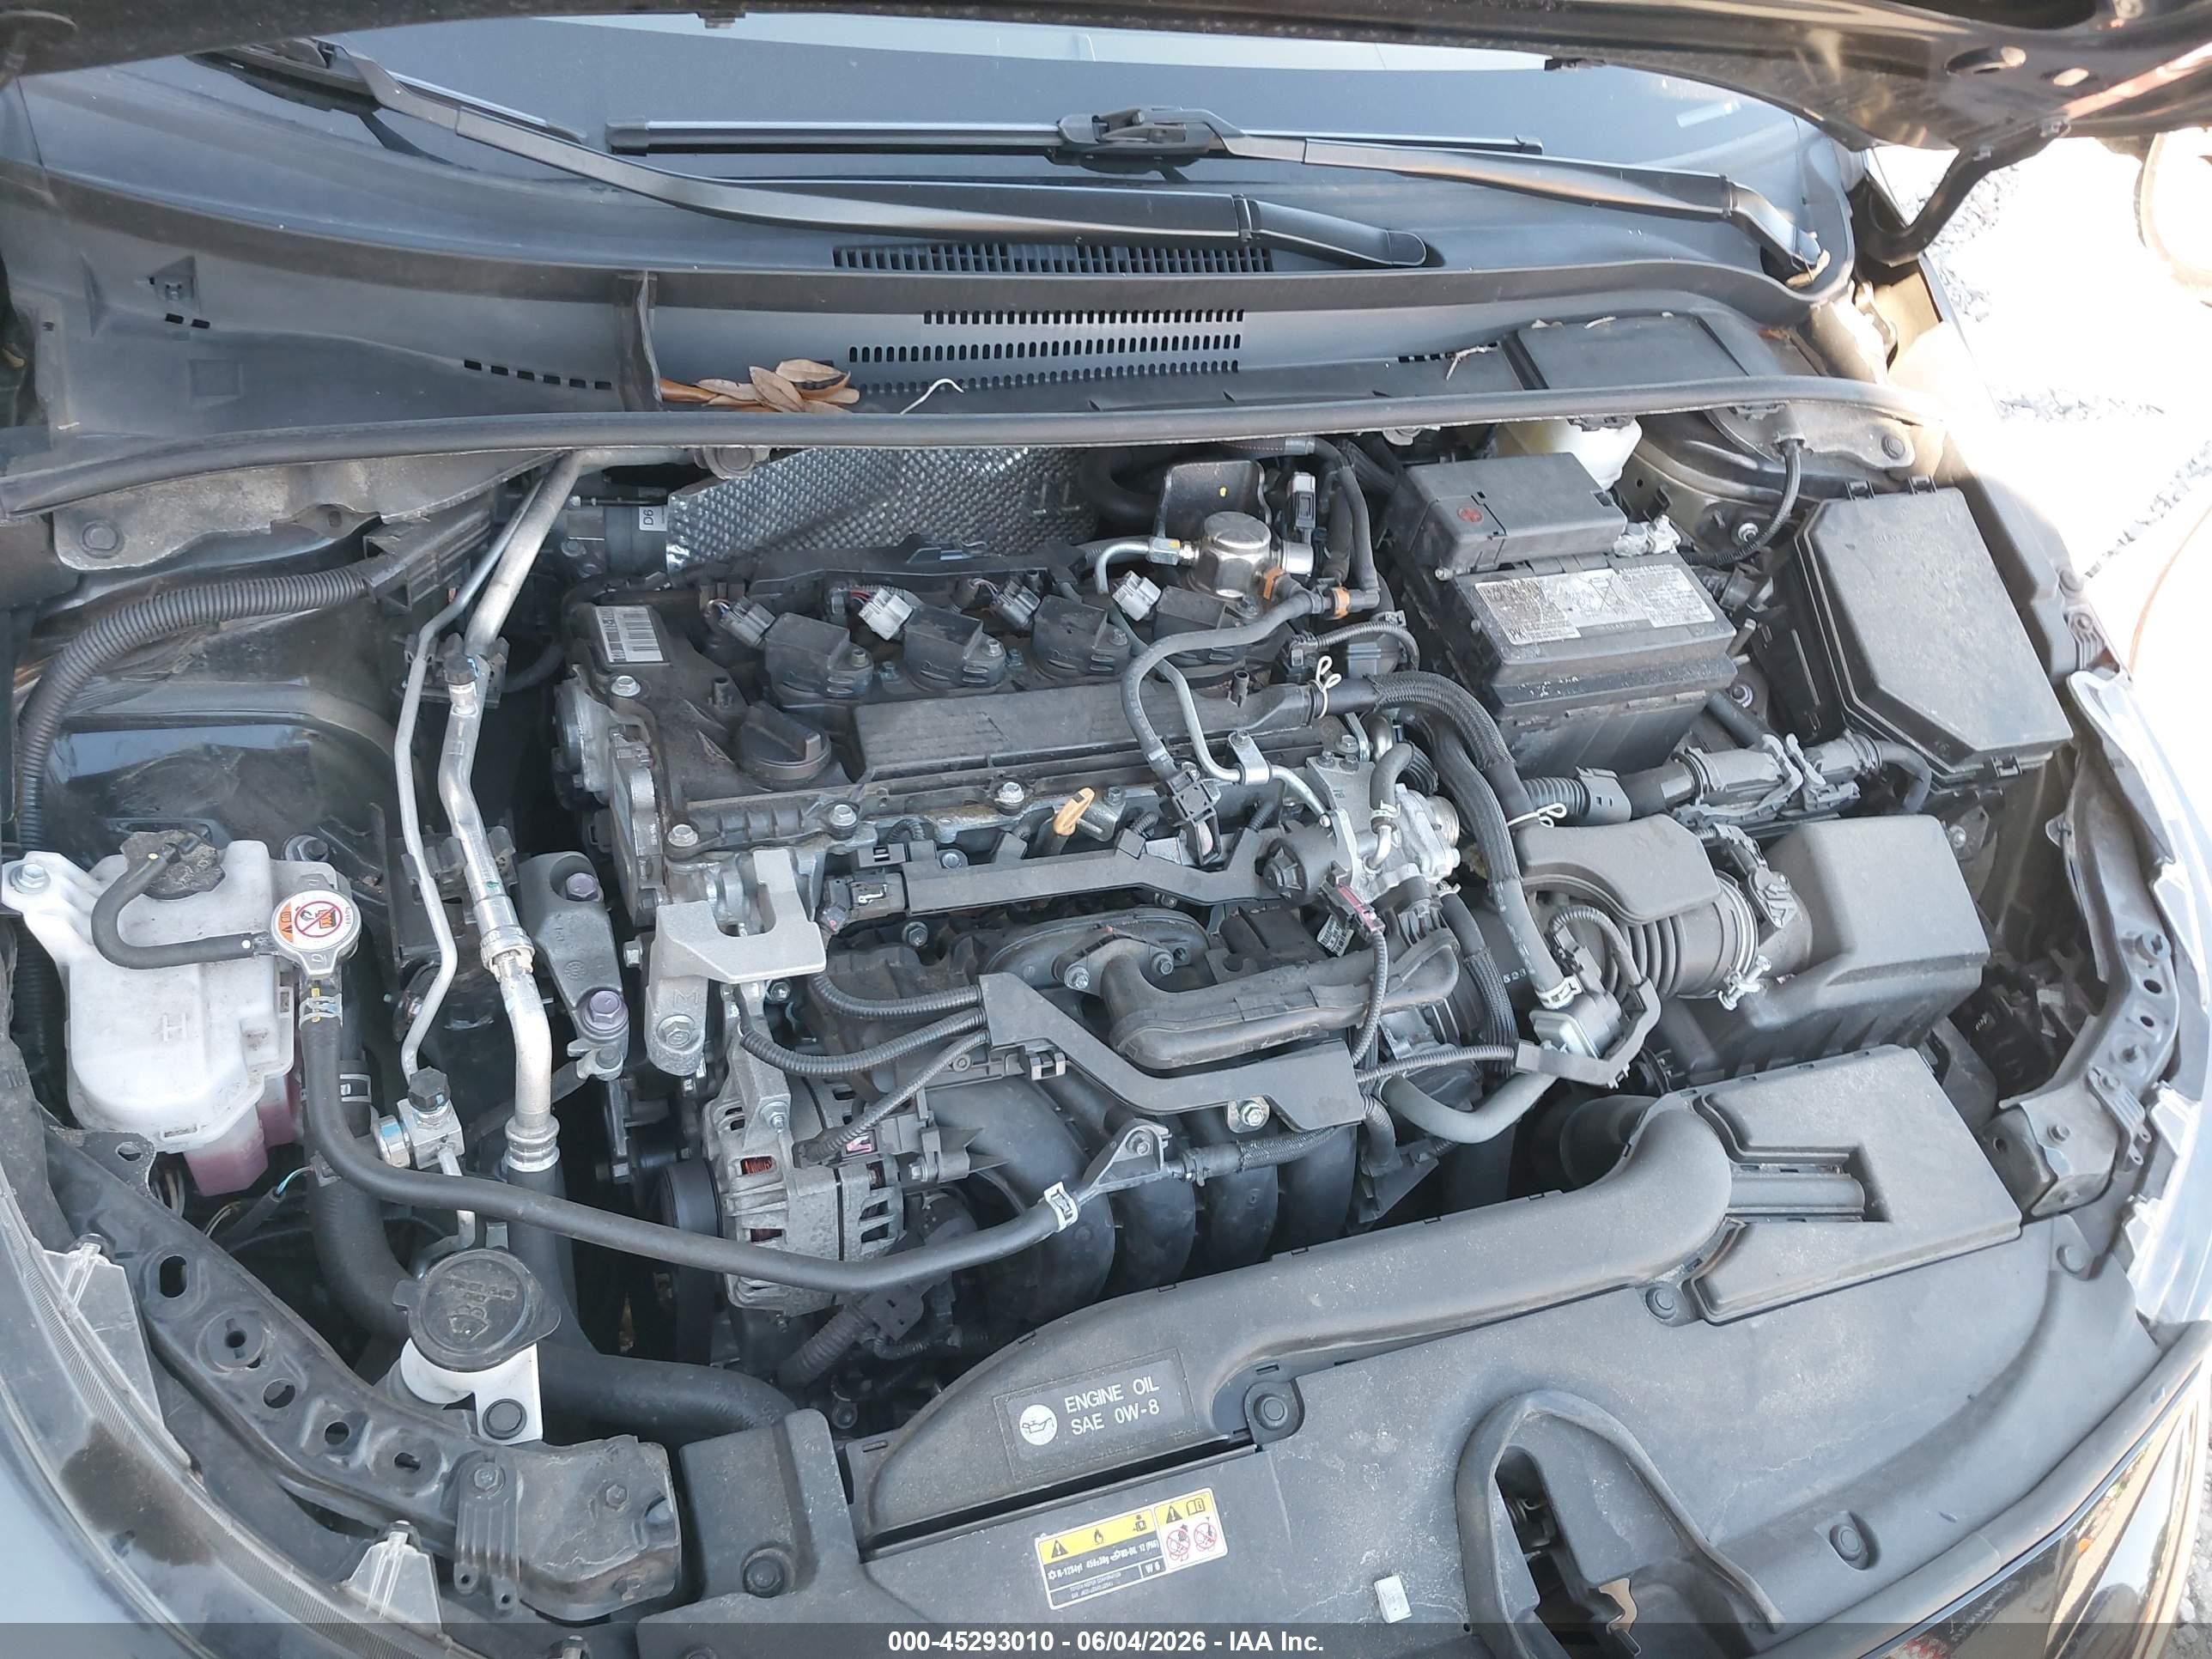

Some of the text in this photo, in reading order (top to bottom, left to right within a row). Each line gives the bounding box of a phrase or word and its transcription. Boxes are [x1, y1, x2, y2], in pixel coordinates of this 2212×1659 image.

[1064, 1375, 1160, 1414] ENGINE OIL
[1071, 1398, 1160, 1436] SAE 0W-8
